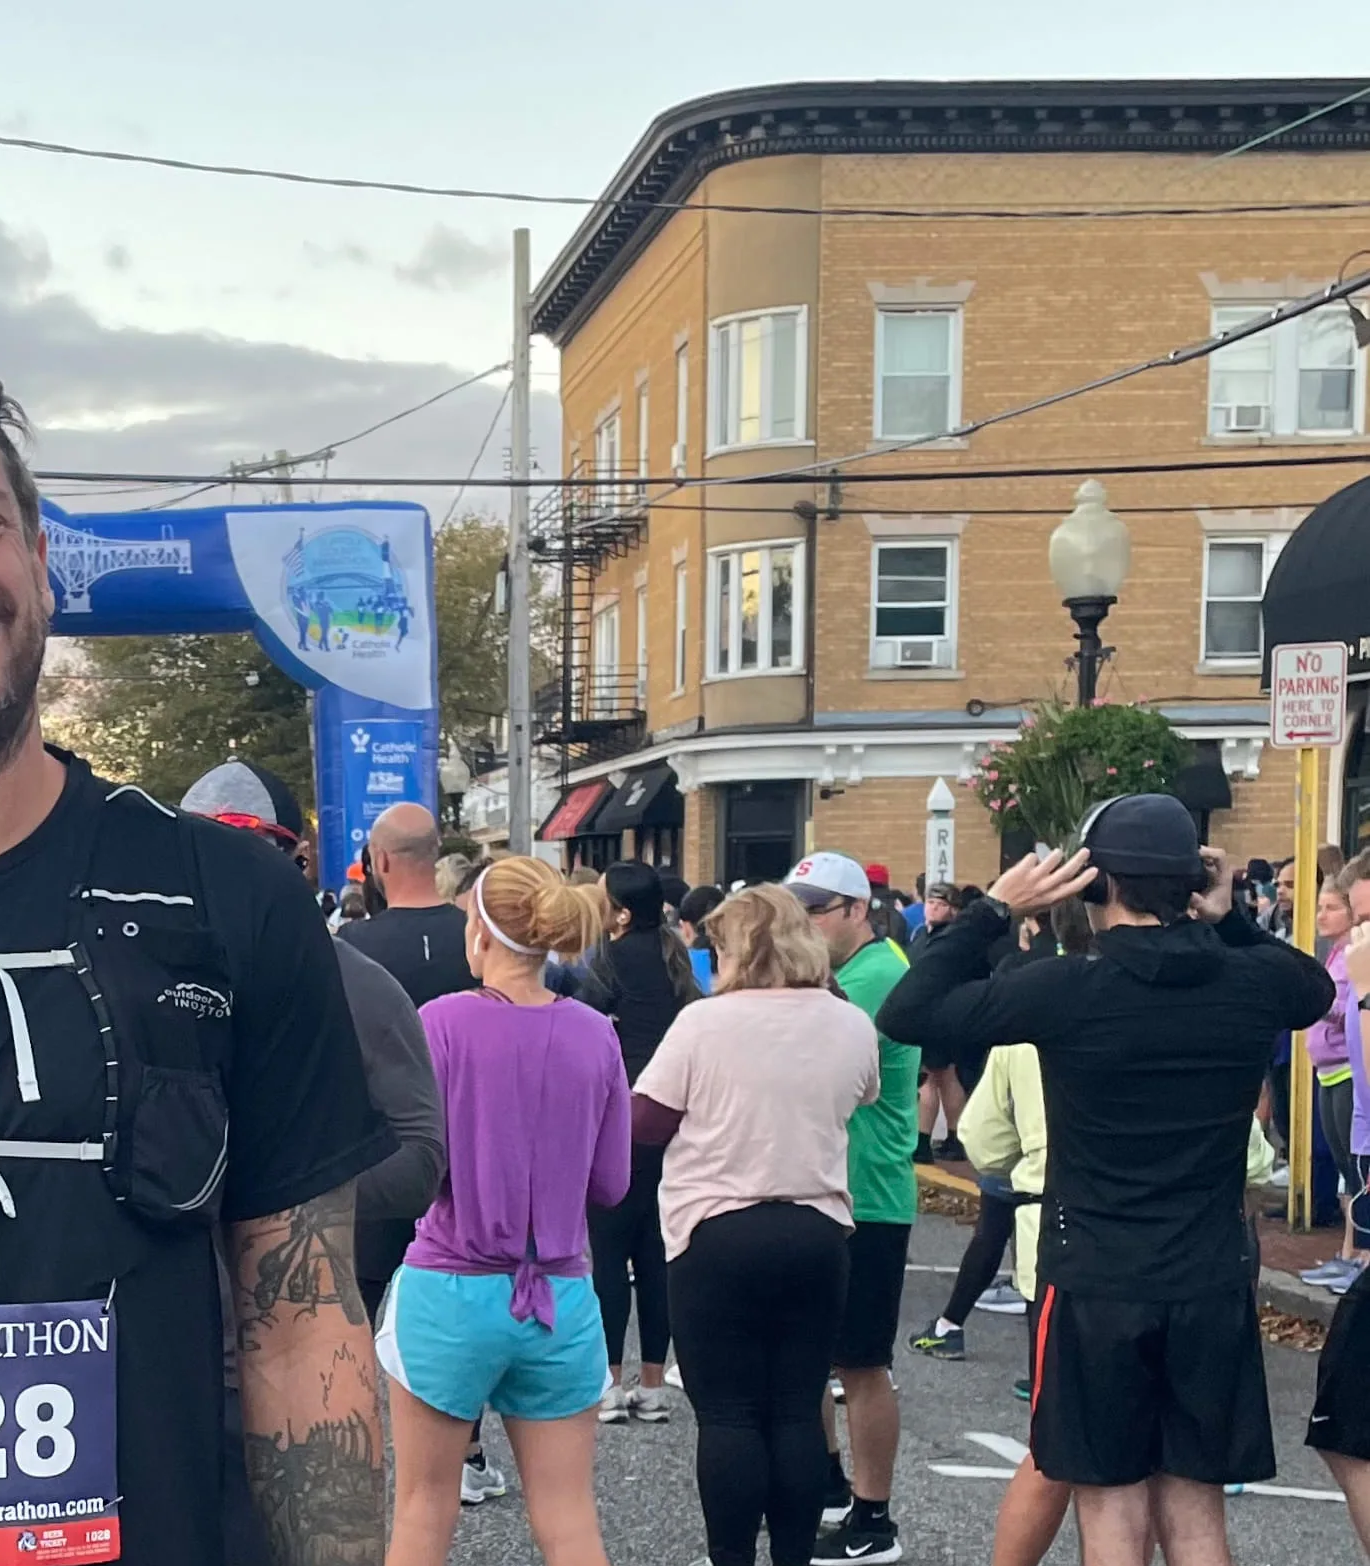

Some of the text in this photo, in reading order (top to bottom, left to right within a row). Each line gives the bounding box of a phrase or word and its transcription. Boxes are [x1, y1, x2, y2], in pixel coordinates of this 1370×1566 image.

[1296, 654, 1322, 673] NO
[1279, 676, 1339, 697] PARKING
[1282, 699, 1335, 713] HERE TO
[1283, 713, 1333, 728] CORNER
[372, 742, 417, 753] Catholic
[372, 753, 410, 764] Health
[164, 989, 214, 1004] outdoor
[174, 998, 224, 1018] INOXTO
[85, 1529, 111, 1542] 1028
